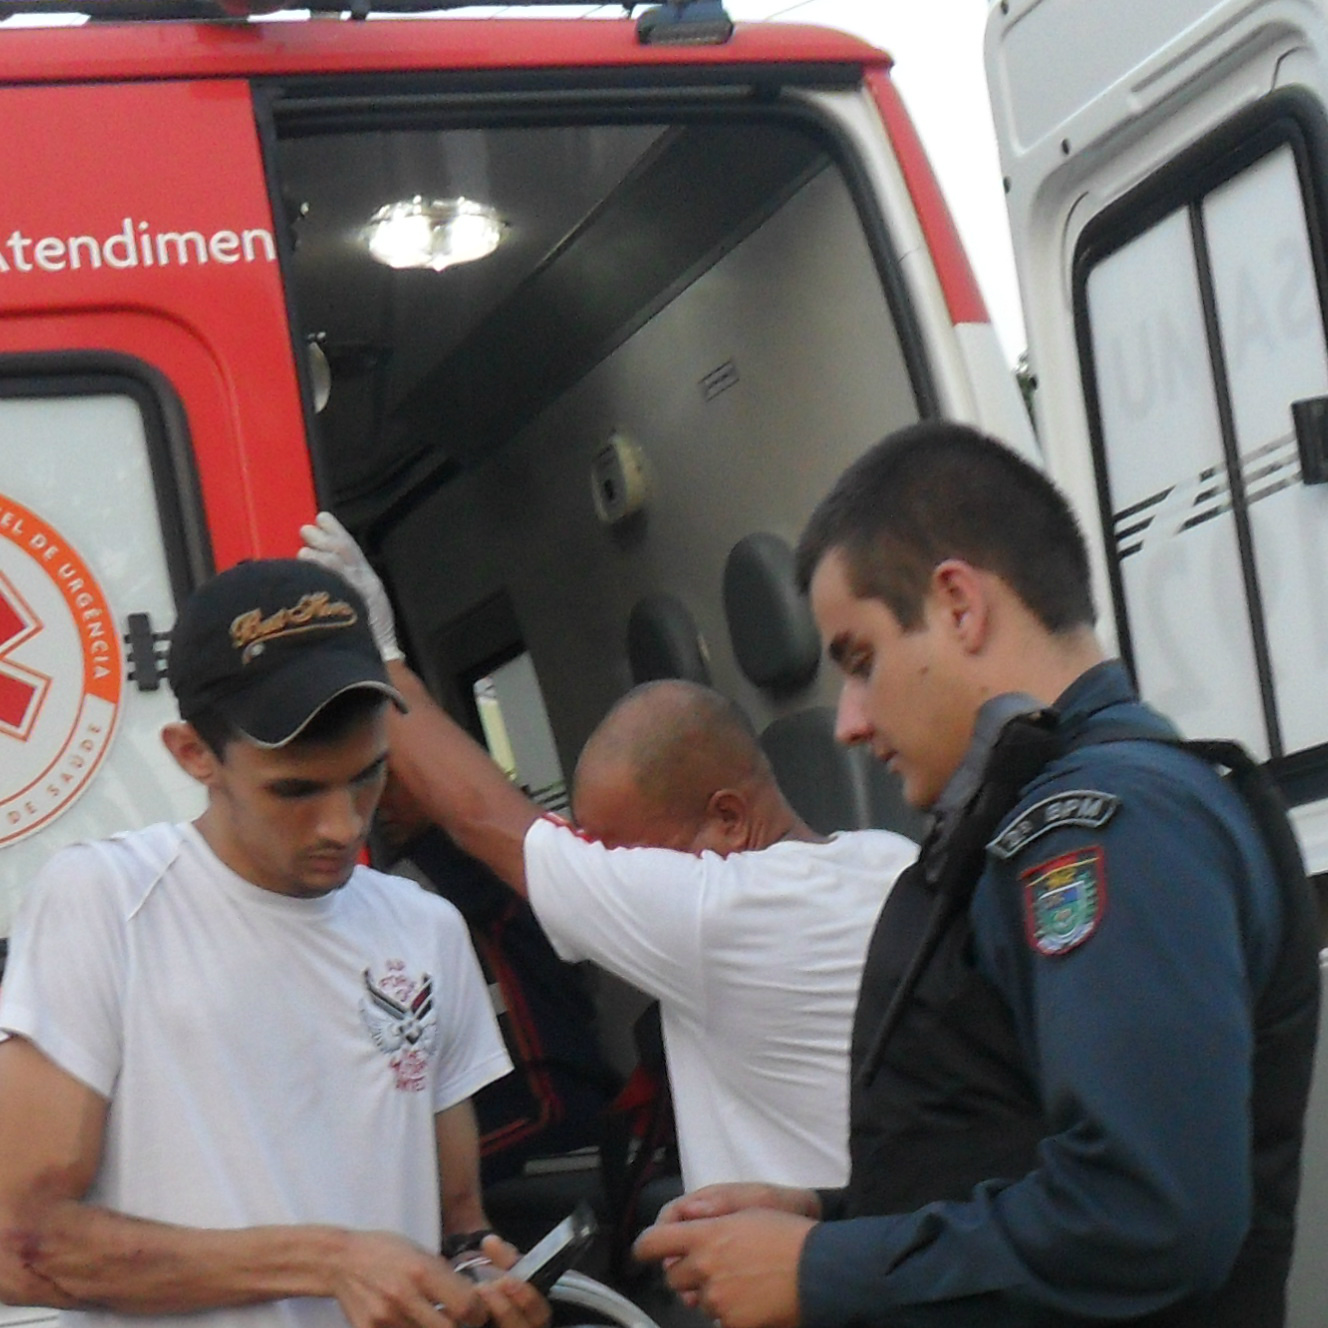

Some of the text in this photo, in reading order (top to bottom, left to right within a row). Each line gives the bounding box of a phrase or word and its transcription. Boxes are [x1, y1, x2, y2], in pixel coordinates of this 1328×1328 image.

[29, 533, 59, 561] DE
[57, 563, 111, 680] URGÊNCIA
[7, 801, 38, 825] DE
